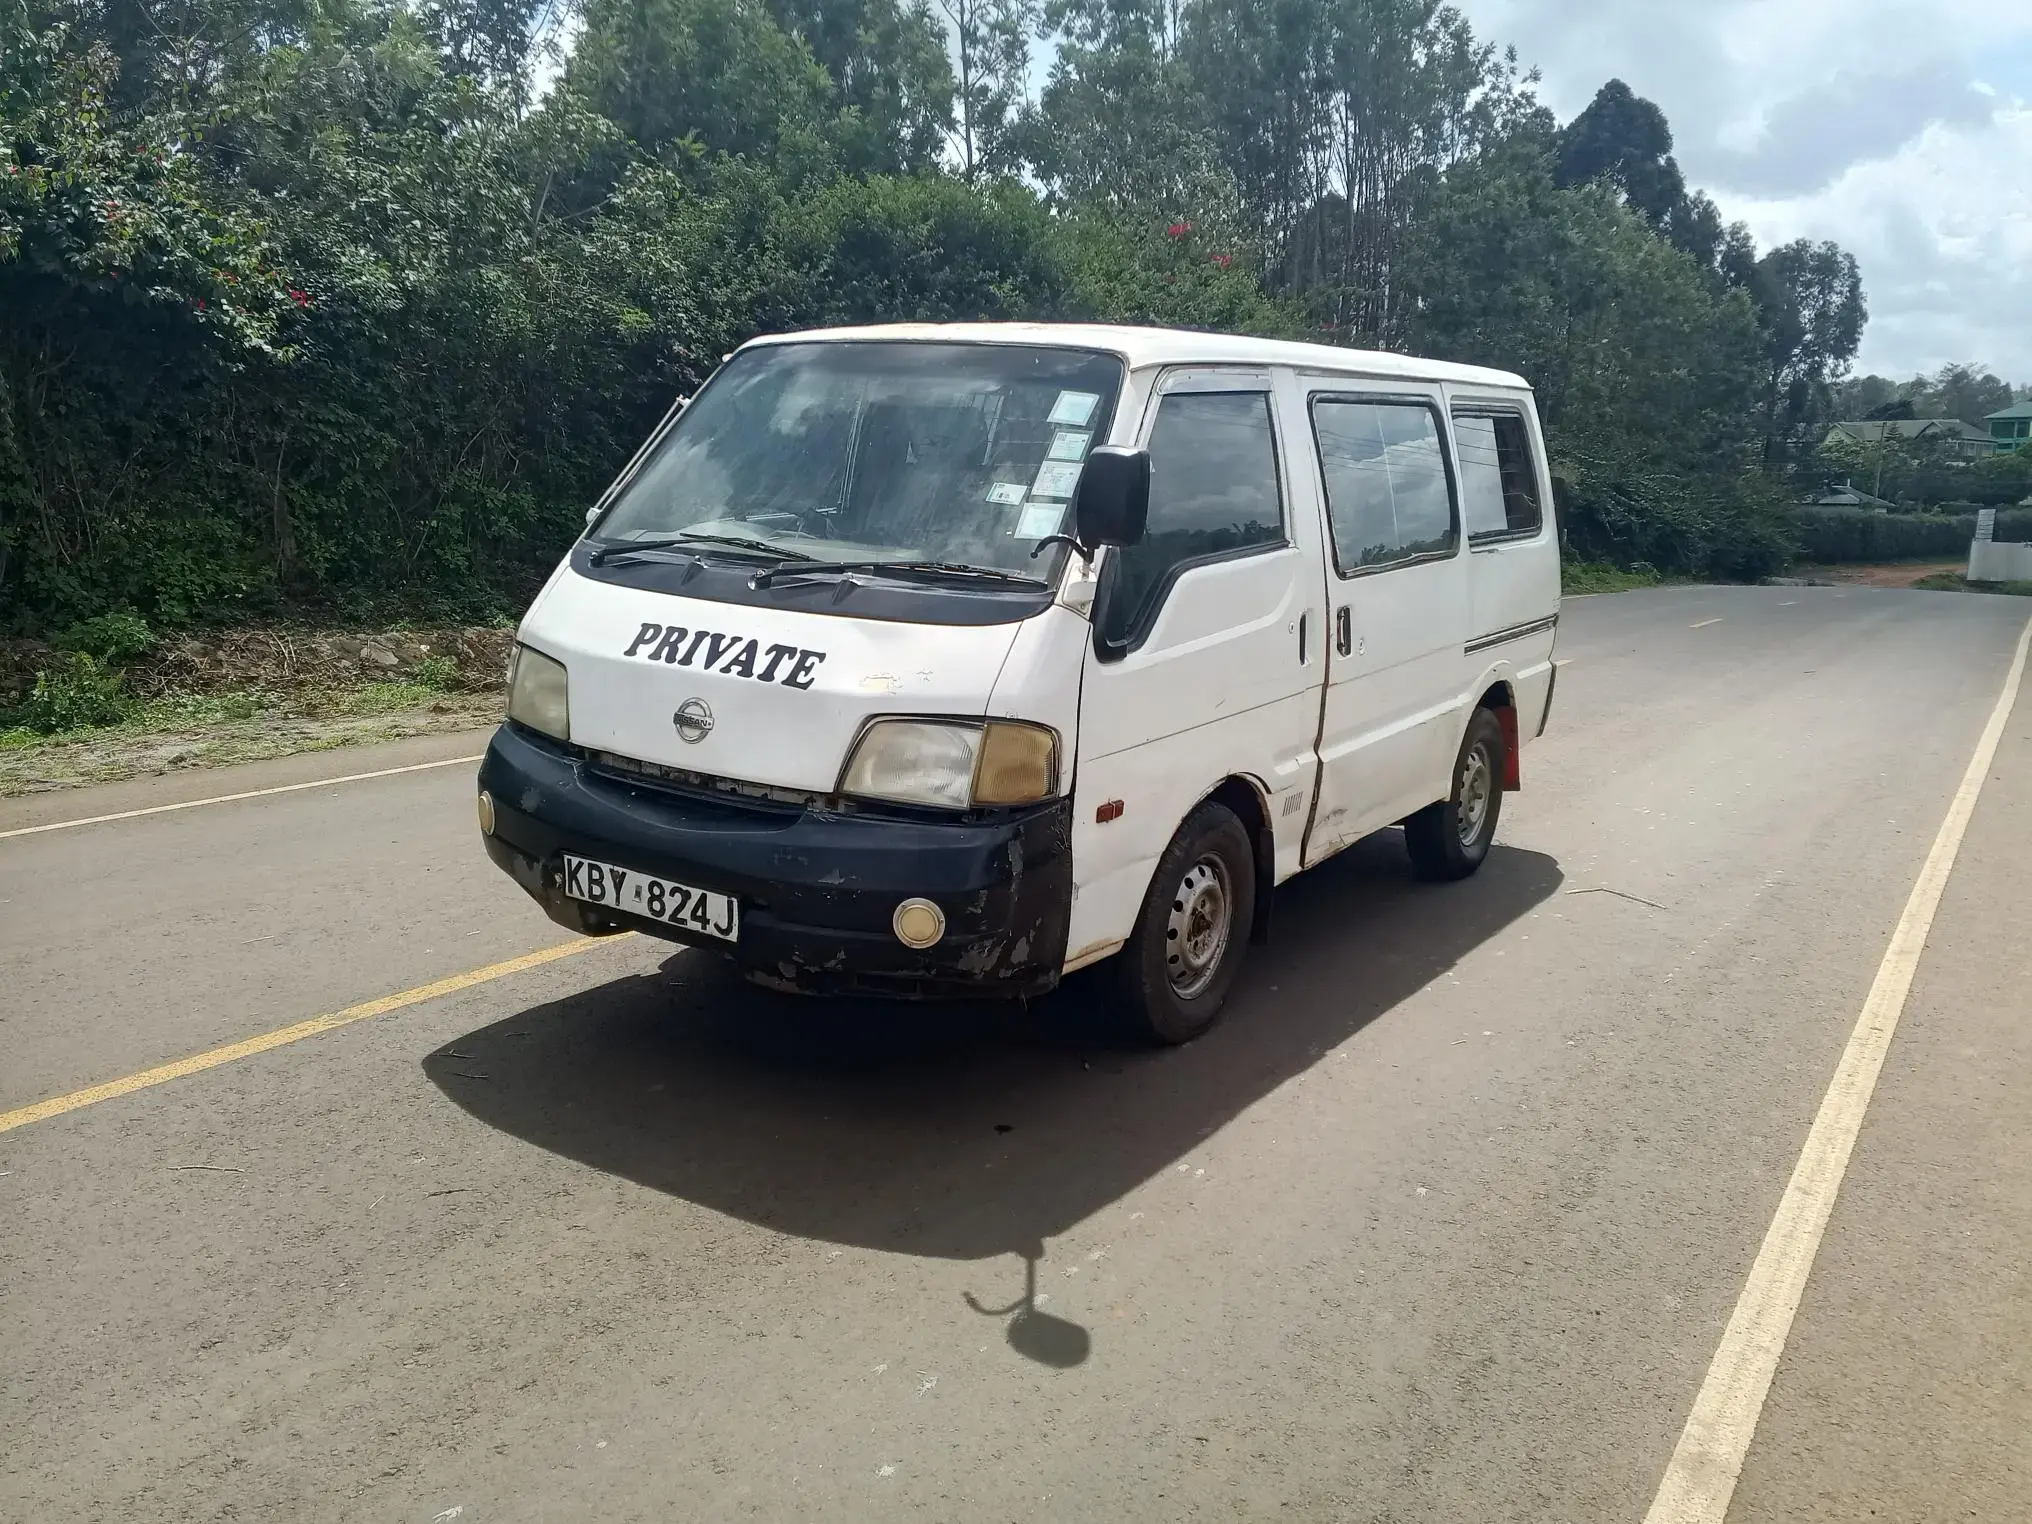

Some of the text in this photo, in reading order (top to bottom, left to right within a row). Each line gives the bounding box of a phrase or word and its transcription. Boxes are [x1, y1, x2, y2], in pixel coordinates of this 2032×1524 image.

[623, 622, 827, 691] PRIVATE
[566, 857, 735, 936] KBY 824J
